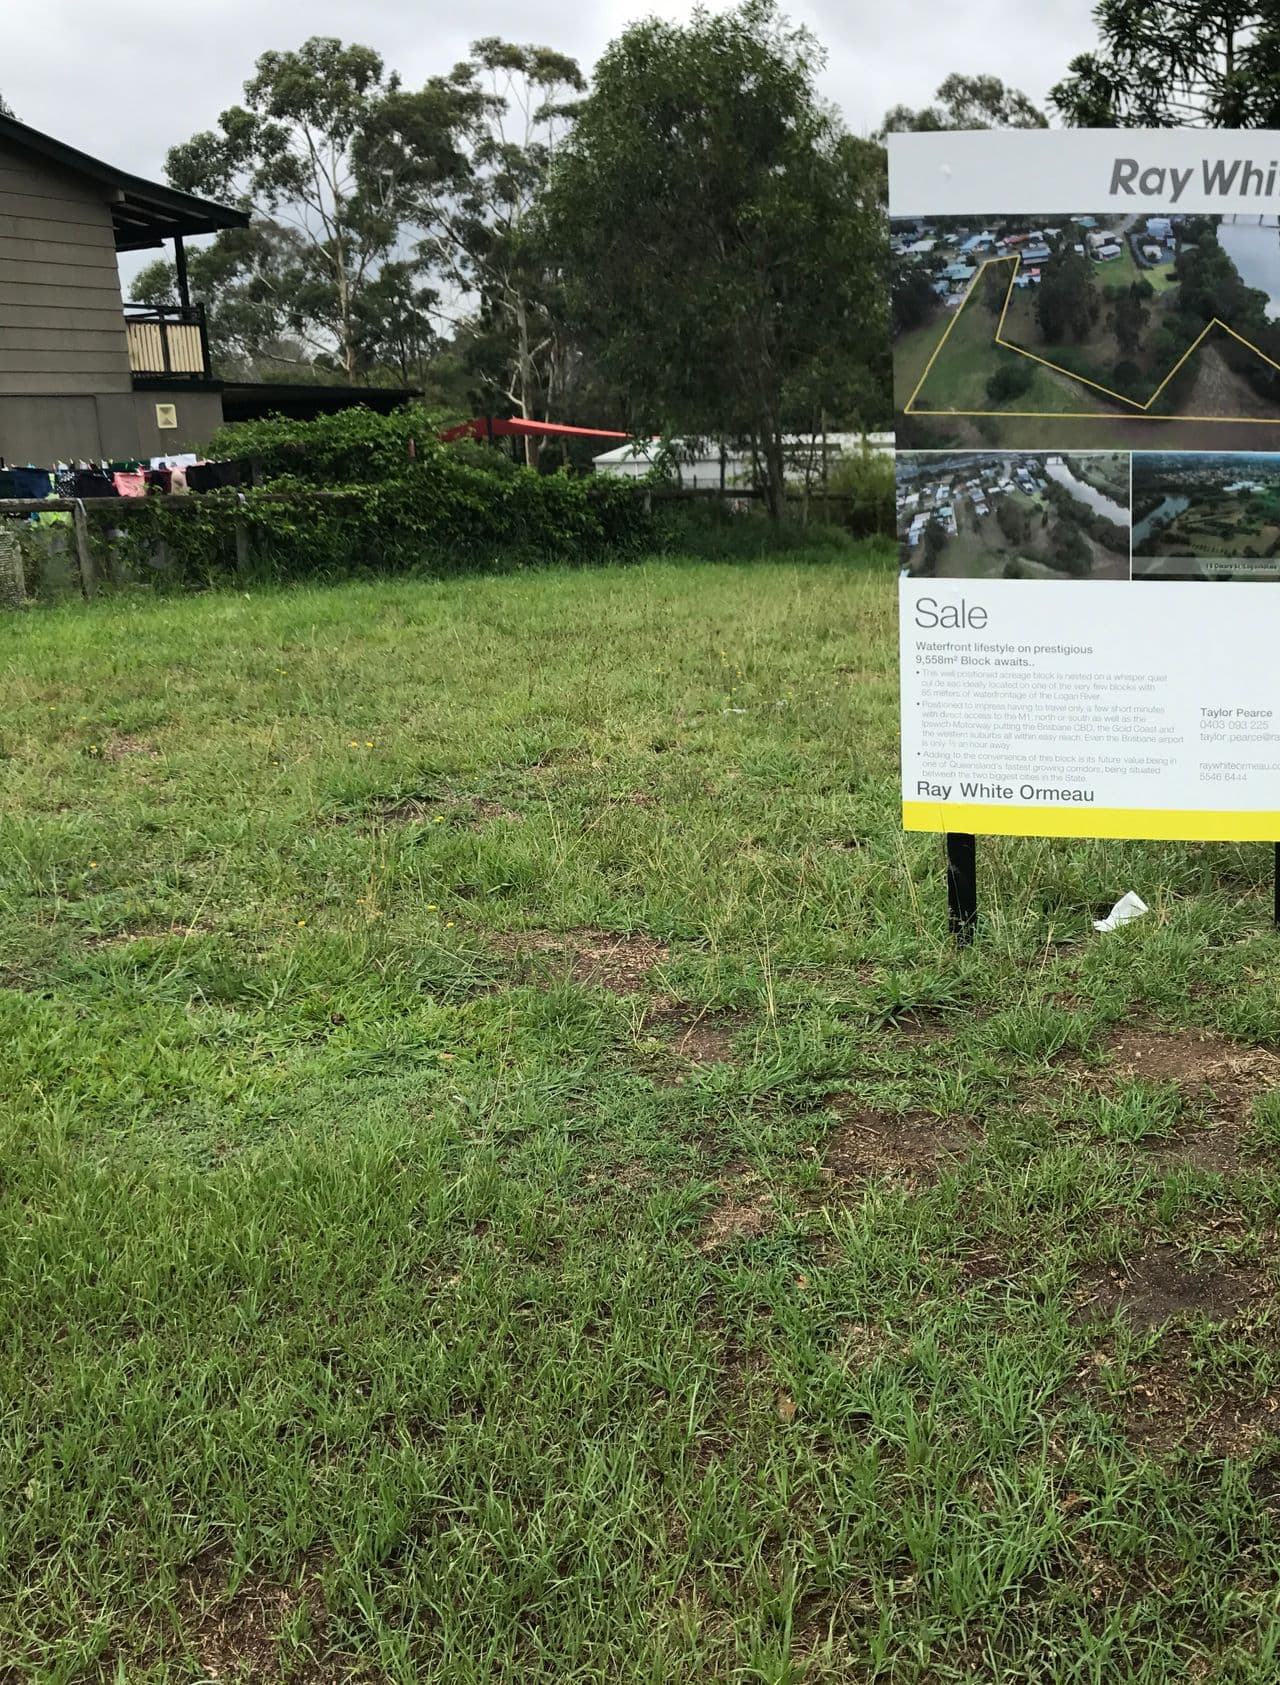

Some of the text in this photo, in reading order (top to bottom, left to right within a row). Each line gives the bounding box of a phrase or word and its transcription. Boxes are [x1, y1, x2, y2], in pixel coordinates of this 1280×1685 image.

[1109, 158, 1194, 203] Ray
[915, 597, 988, 629] Sale
[916, 642, 972, 651] Waterfront
[974, 643, 1015, 654] lifestyle
[1033, 645, 1093, 656] prestigious
[961, 656, 991, 665] Block
[922, 669, 938, 677] This
[957, 670, 997, 680] positioned
[999, 672, 1031, 680] acreage
[1034, 671, 1055, 679] block
[1114, 673, 1144, 682] whisper
[1148, 673, 1167, 683] quiet
[922, 679, 933, 687] cul
[963, 680, 987, 690] ideally
[989, 680, 1017, 689] located
[1074, 683, 1090, 691] very
[1094, 682, 1107, 690] few
[1110, 682, 1137, 690] blocks
[1139, 683, 1155, 691] with
[934, 689, 961, 697] meters
[974, 690, 1026, 700] waterfrontage
[1040, 691, 1052, 699] the
[1054, 691, 1078, 701] Logan
[922, 700, 963, 709] Positioned
[974, 701, 1006, 711] impress
[1008, 702, 1033, 712] having
[1046, 703, 1066, 711] travel
[1068, 703, 1083, 713] only
[1094, 704, 1108, 712] few
[1111, 704, 1131, 712] short
[1134, 704, 1165, 713] minutes
[1200, 707, 1273, 718] Taylor Pearce
[922, 710, 938, 718] with
[940, 710, 962, 718] direct
[1004, 711, 1016, 719] the
[1035, 712, 1055, 720] north
[1069, 713, 1090, 721] south
[1104, 714, 1119, 722] well
[1134, 714, 1146, 722] the
[922, 720, 951, 730] Ipswich
[952, 720, 990, 730] Motorway
[994, 721, 1020, 731] putting
[1022, 722, 1036, 730] the
[1037, 722, 1071, 731] Brisbane
[1098, 723, 1110, 731] the
[1112, 724, 1132, 732] Gold
[1134, 724, 1156, 732] Coast
[1159, 725, 1174, 733] and
[1200, 719, 1226, 729] 0403
[1250, 720, 1269, 730] 225
[937, 730, 968, 738] western
[970, 730, 1002, 739] suburbs
[1014, 731, 1036, 740] within
[1038, 733, 1057, 742] easy
[1085, 733, 1104, 741] Even
[1106, 733, 1119, 741] the
[1122, 734, 1156, 742] Brisbane
[1159, 734, 1184, 744] airport
[930, 739, 944, 749] only
[923, 751, 950, 761] Adding
[963, 752, 976, 760] the
[978, 752, 1026, 761] convenience
[1039, 754, 1054, 762] this
[1055, 754, 1076, 762] block
[1086, 755, 1096, 763] its
[1098, 755, 1120, 763] future
[1124, 756, 1144, 764] value
[1146, 756, 1168, 766] being
[1006, 762, 1030, 770] fastest
[1033, 763, 1064, 773] growing
[1105, 765, 1126, 775] being
[1129, 765, 1160, 774] situated
[922, 770, 956, 778] between
[958, 771, 970, 779] the
[972, 771, 988, 779] two
[990, 771, 1018, 781] biggest
[1020, 772, 1040, 780] cities
[1050, 773, 1063, 781] the
[917, 780, 1094, 802] Ray White Ormeau
